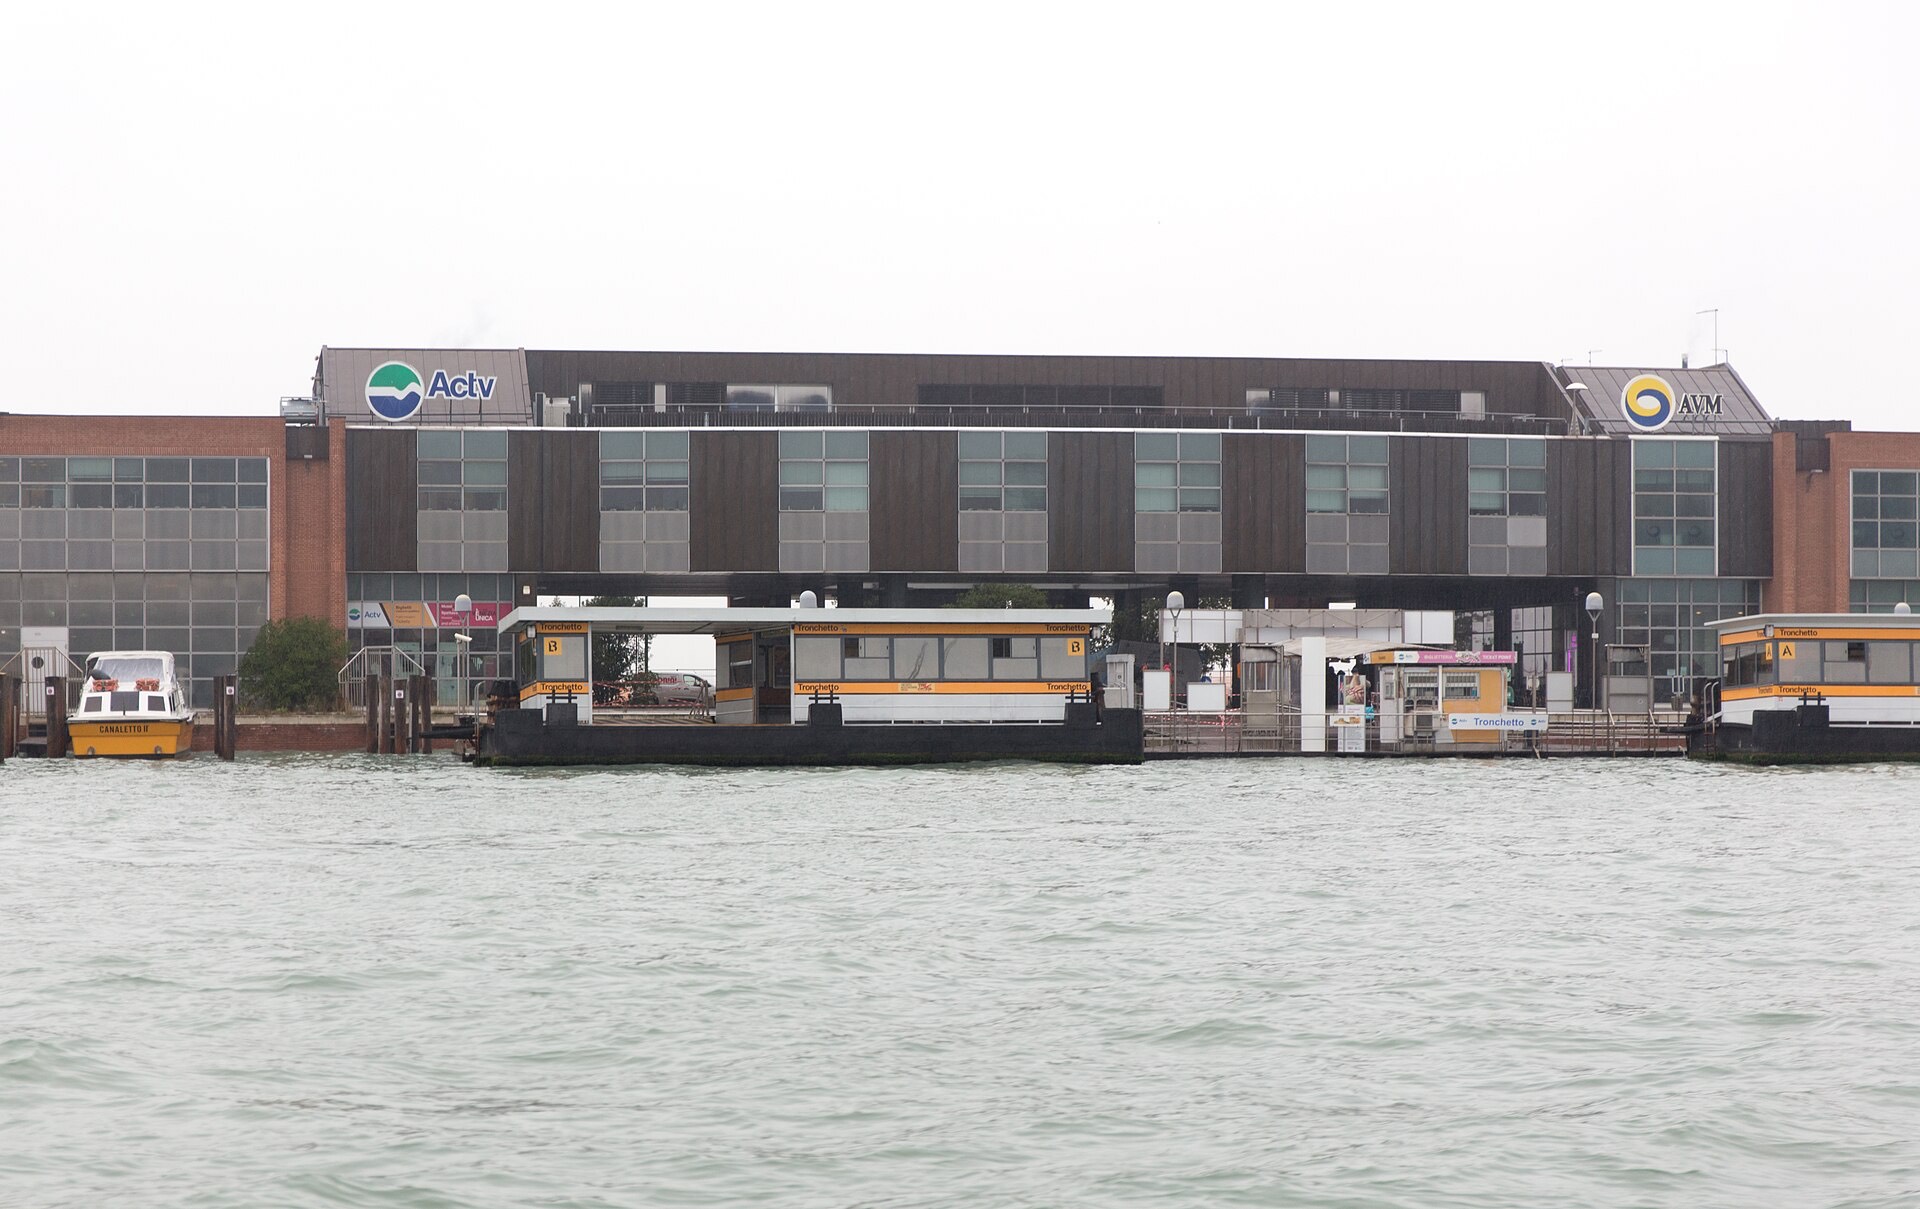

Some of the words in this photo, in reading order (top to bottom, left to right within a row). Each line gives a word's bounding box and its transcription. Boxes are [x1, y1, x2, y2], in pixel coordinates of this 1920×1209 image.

[426, 370, 496, 399] Actv
[1678, 394, 1722, 414] AVM
[798, 624, 838, 632] Tronchetto
[548, 640, 558, 652] B
[1071, 641, 1080, 652] B
[1783, 645, 1792, 656] A
[1474, 717, 1524, 727] Tronchetto
[99, 725, 142, 733] CANALETTO
